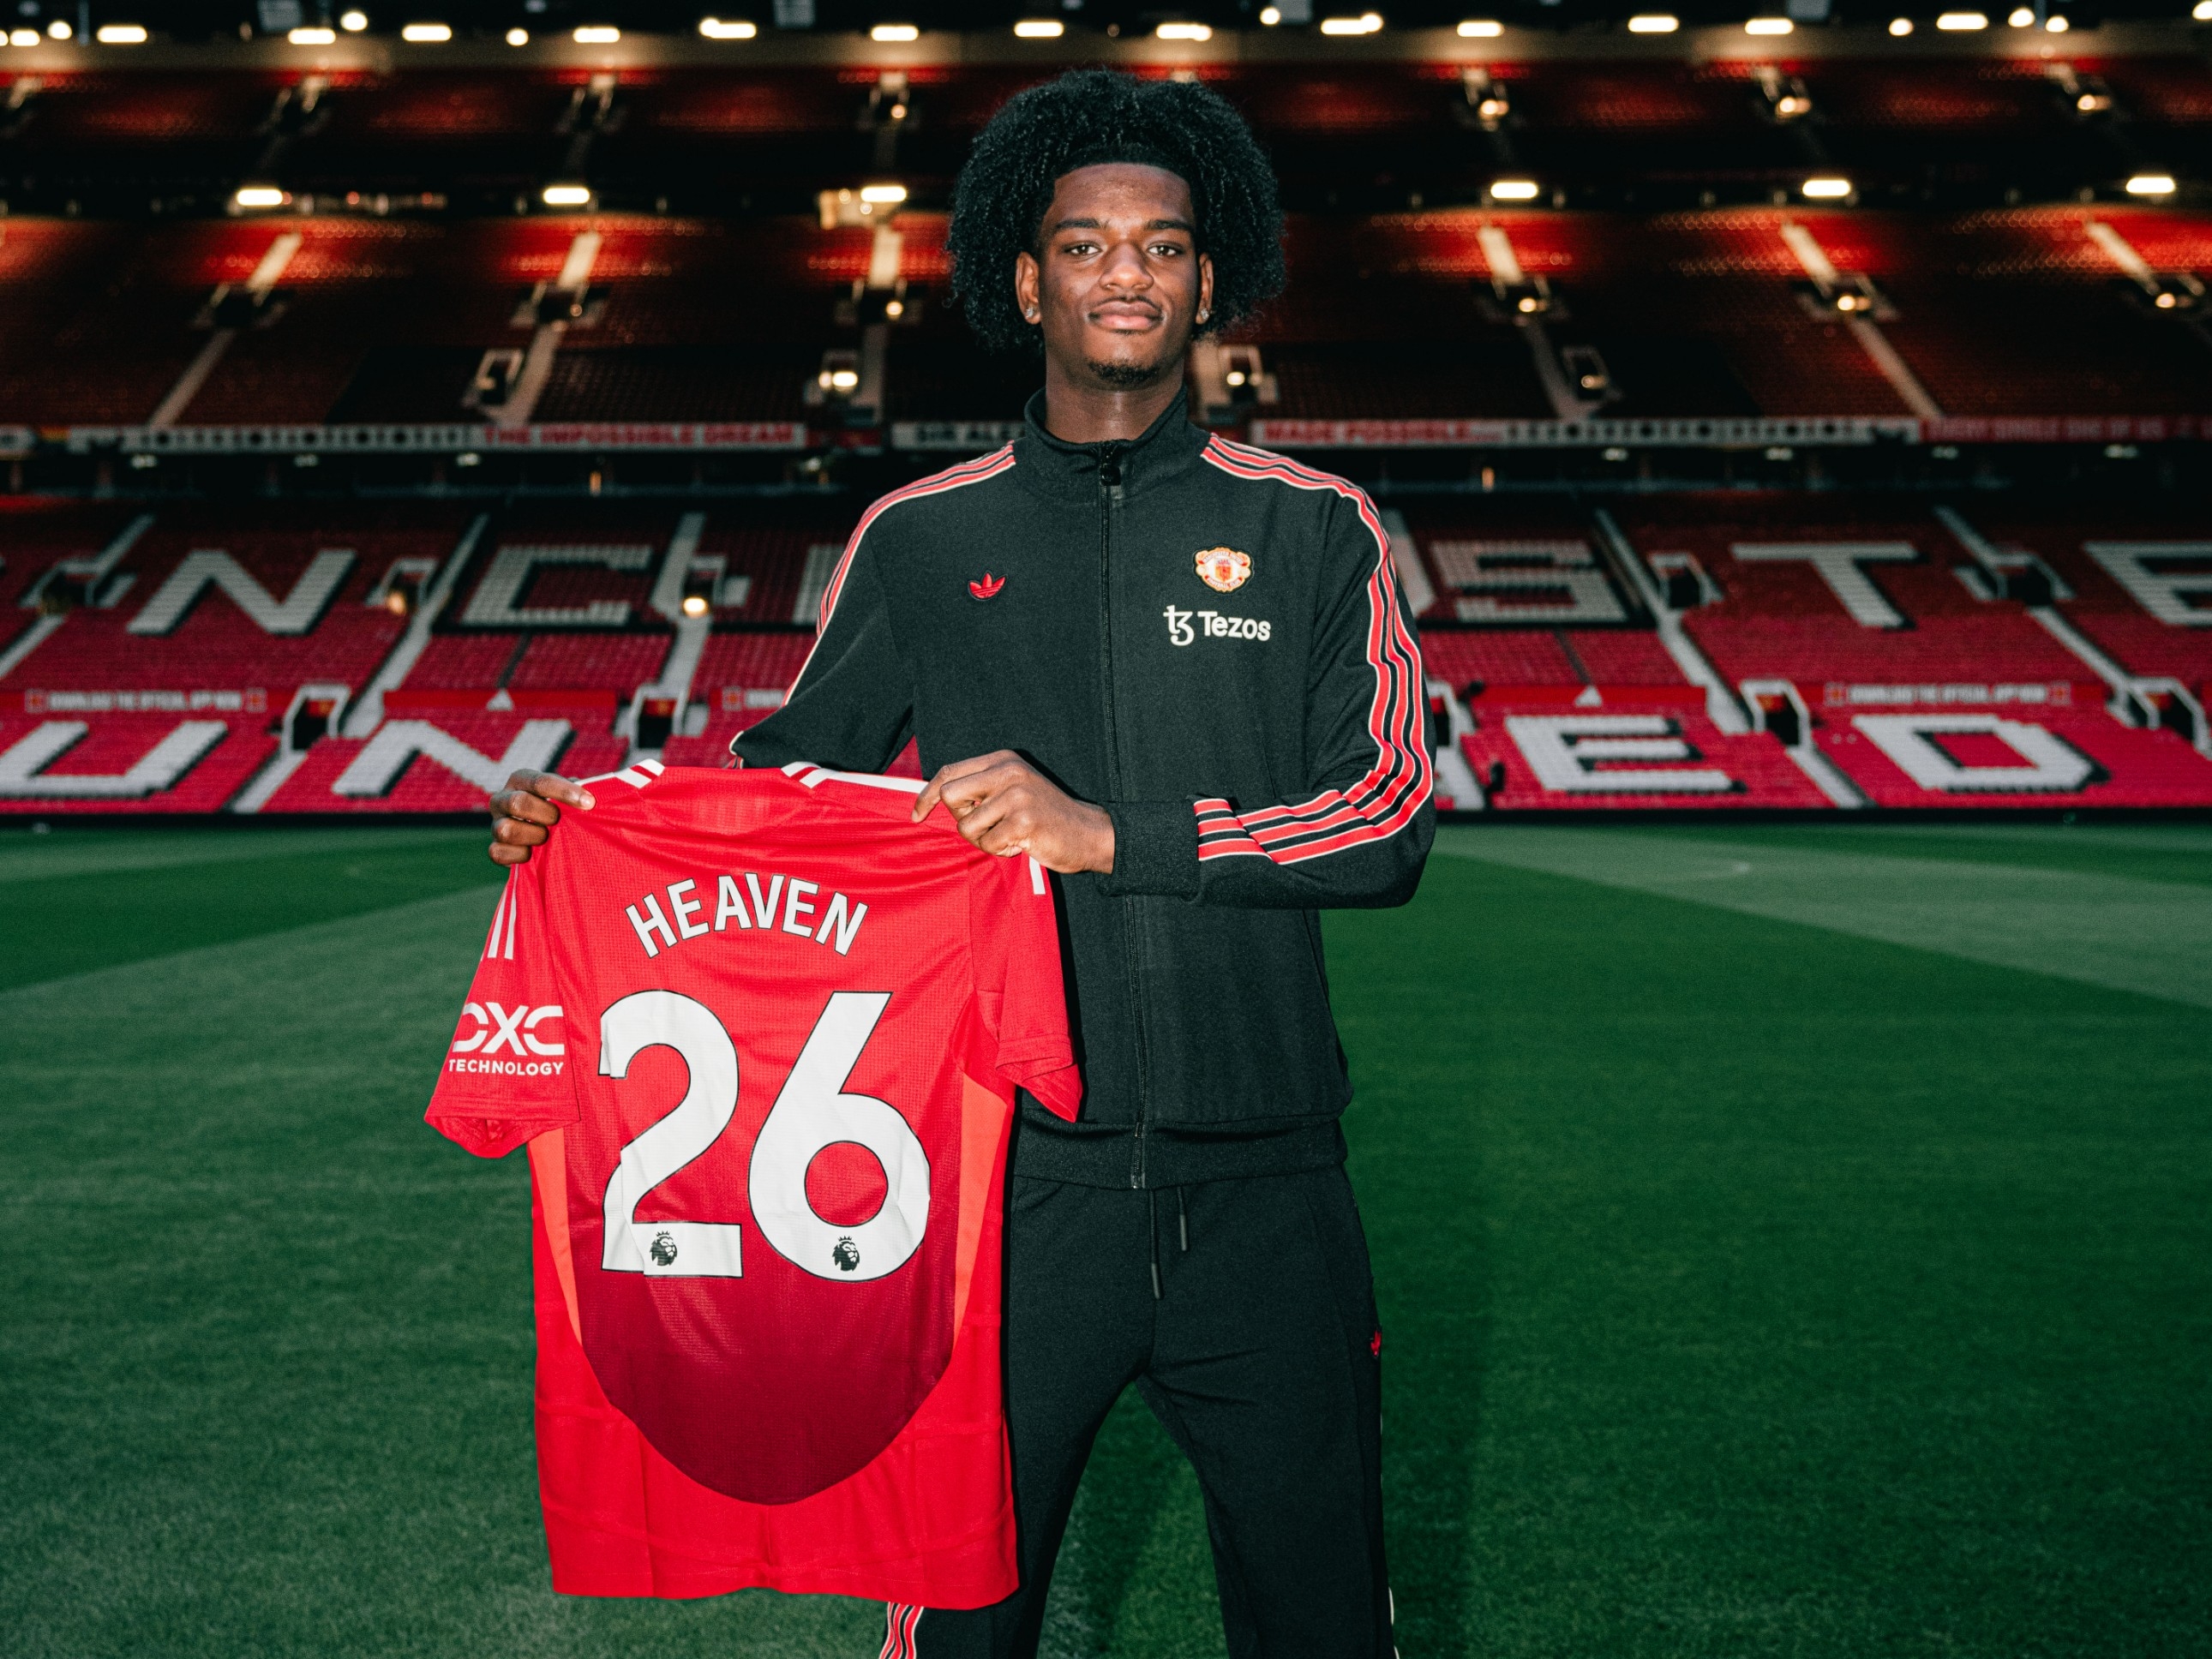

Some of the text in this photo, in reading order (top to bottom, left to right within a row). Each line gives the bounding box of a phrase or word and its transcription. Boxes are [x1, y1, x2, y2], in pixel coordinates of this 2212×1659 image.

[1197, 611, 1271, 642] Tezos
[625, 872, 869, 959] HEAVEN
[453, 1002, 565, 1056] DXC
[449, 1058, 564, 1076] TECHNOLOGY
[598, 989, 931, 1283] 26
